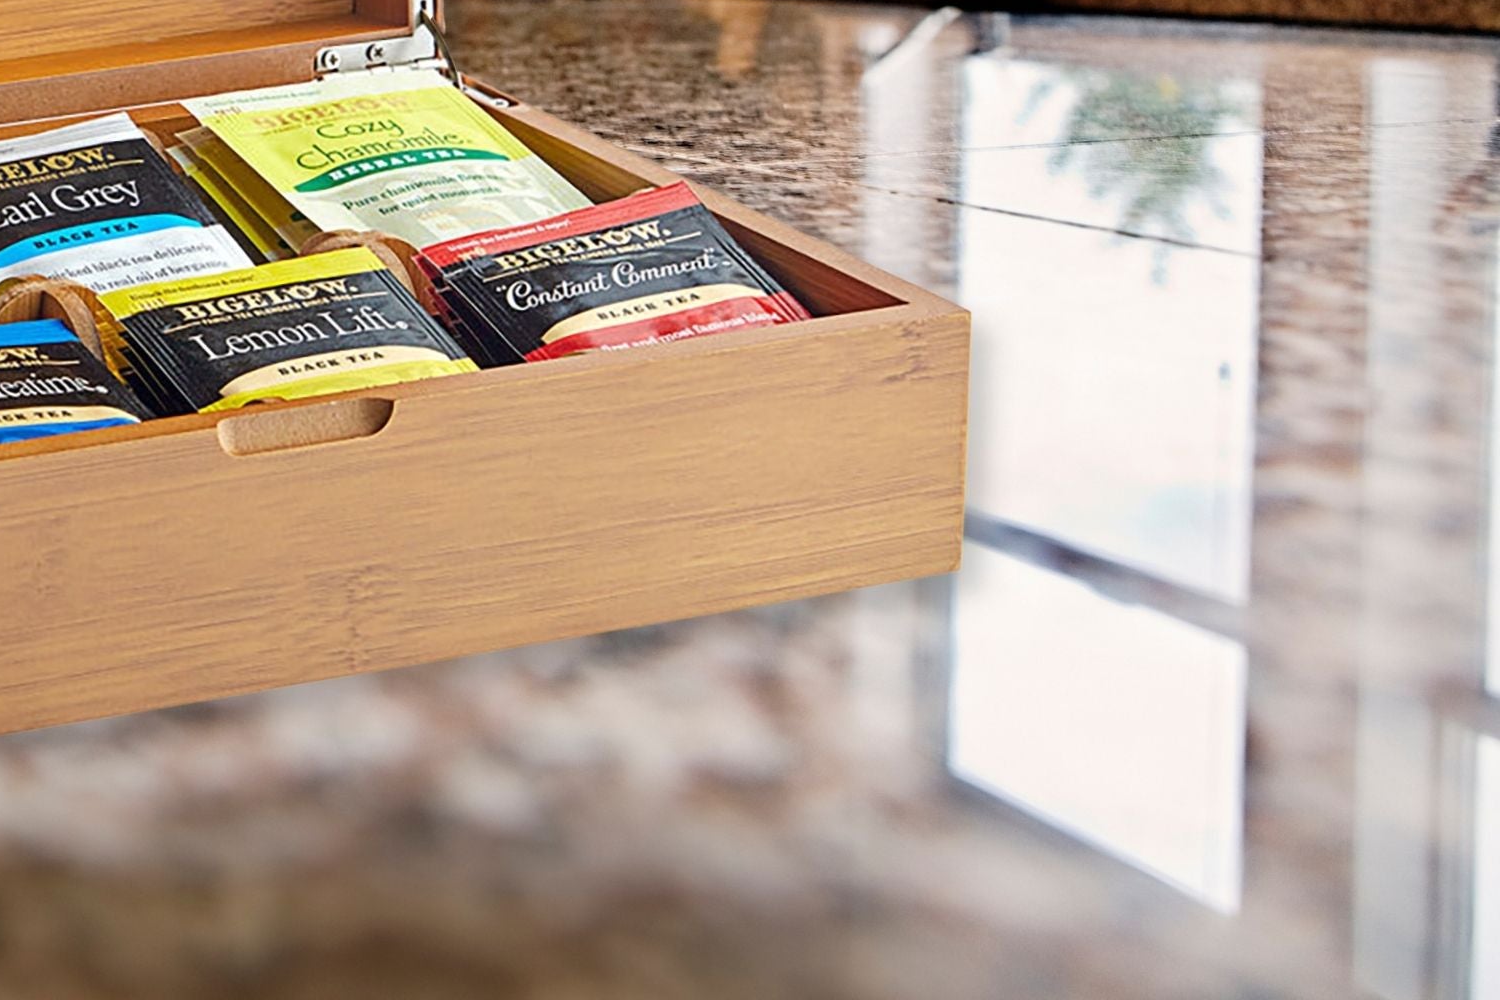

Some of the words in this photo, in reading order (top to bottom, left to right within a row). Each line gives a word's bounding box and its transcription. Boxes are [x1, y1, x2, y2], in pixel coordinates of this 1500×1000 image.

[316, 119, 404, 139] Cozy
[296, 127, 464, 170] Chamomile
[329, 154, 417, 181] HERBAL
[422, 149, 467, 161] TEA
[51, 180, 141, 213] Grey
[341, 195, 379, 211] Pure
[33, 230, 95, 249] BLACK
[101, 222, 139, 235] TEA
[93, 256, 130, 274] black
[131, 254, 152, 265] tea
[596, 302, 658, 321] BLACK
[666, 292, 701, 307] TEA
[189, 321, 330, 362] Lemon
[277, 358, 342, 376] BLACK
[346, 351, 385, 364] TEA
[34, 409, 73, 420] TEA
